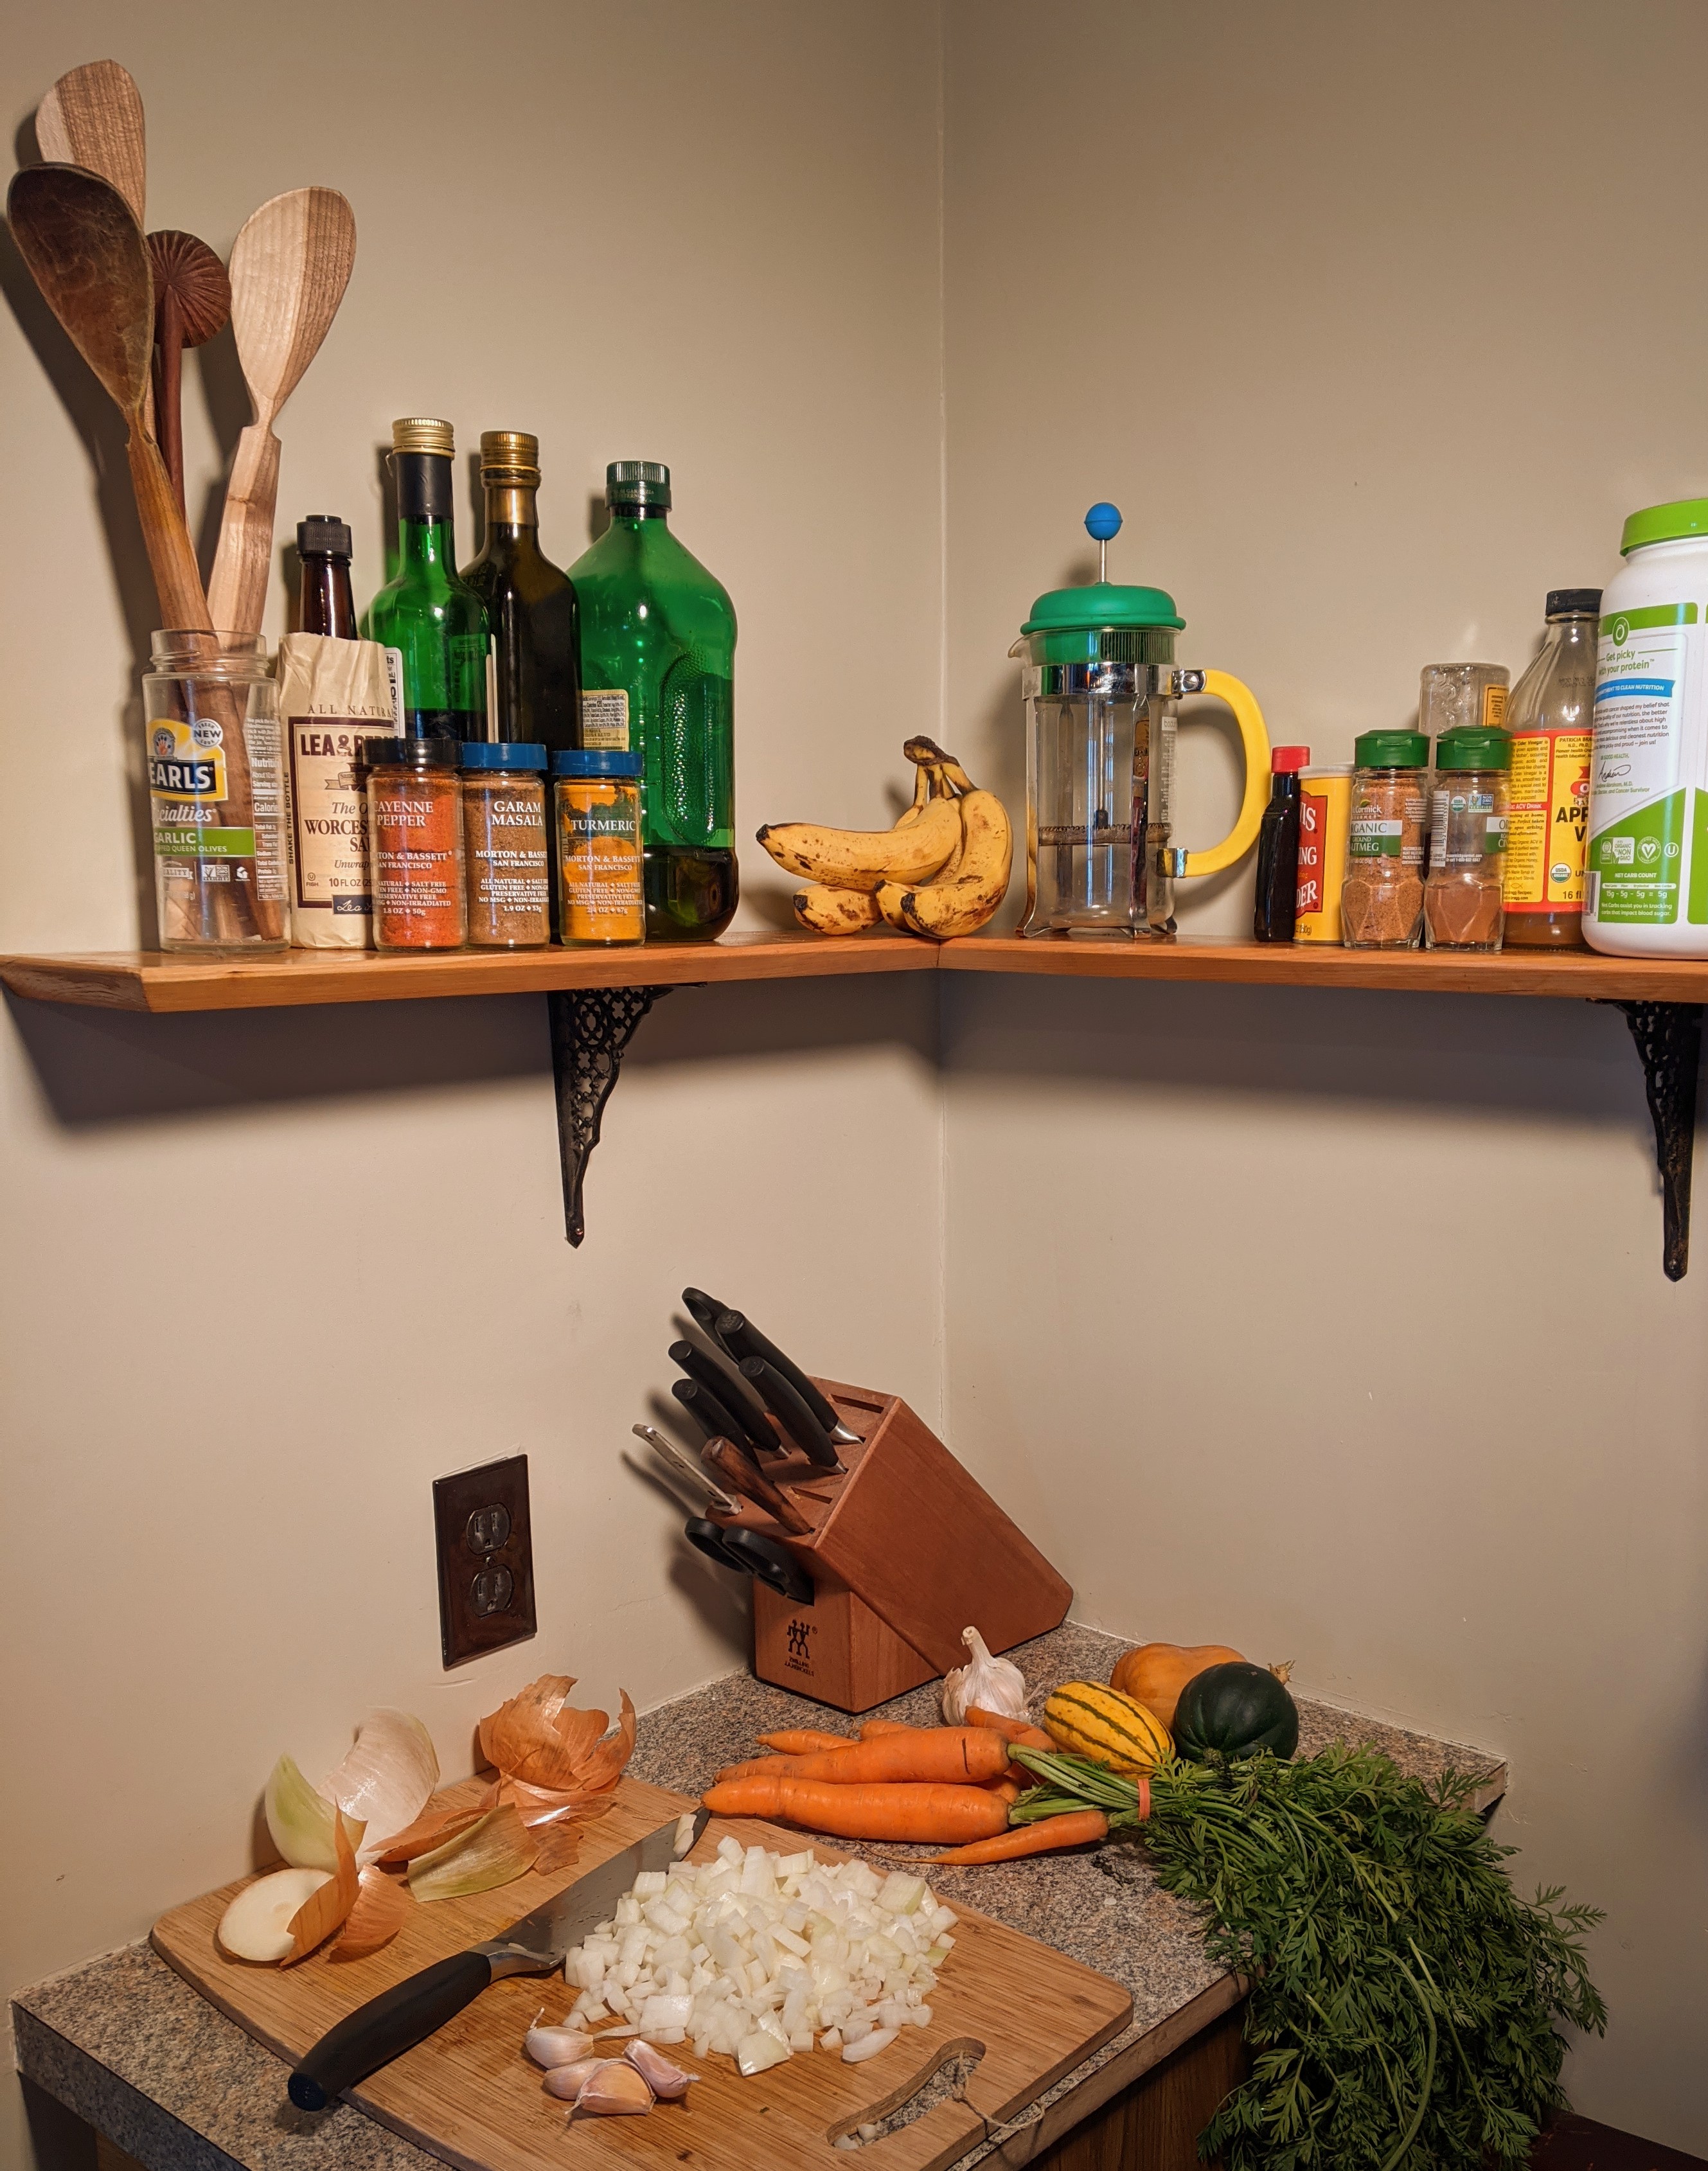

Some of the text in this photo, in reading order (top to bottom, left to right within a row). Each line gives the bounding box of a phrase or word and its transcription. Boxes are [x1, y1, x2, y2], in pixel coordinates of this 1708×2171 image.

[1606, 650, 1635, 662] Get picky
[1607, 665, 1619, 676] your
[1621, 660, 1650, 673] protein
[307, 704, 337, 714] ALL
[332, 802, 355, 814] The
[494, 801, 541, 813] GARAM
[377, 815, 426, 826] PEPPER
[492, 815, 543, 826] MASALA
[571, 820, 636, 831] TURMERIC
[1298, 847, 1317, 865] ING
[329, 878, 339, 887] 10
